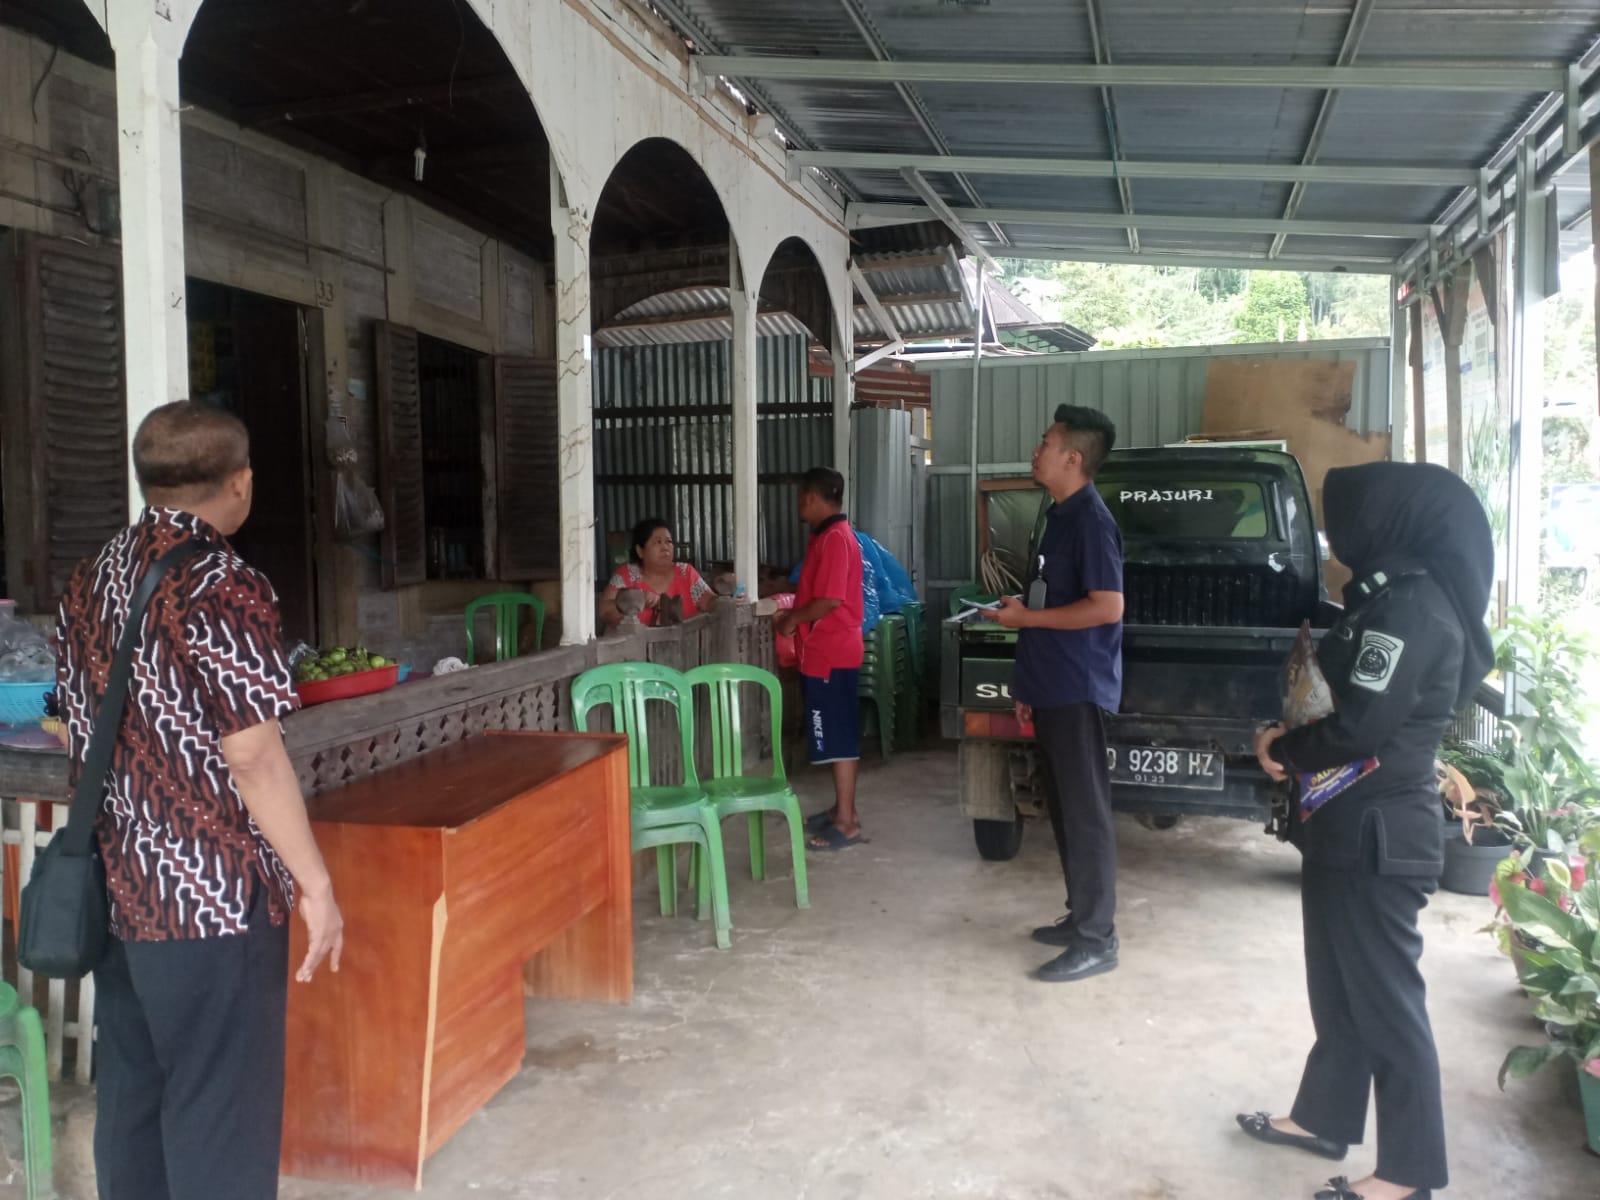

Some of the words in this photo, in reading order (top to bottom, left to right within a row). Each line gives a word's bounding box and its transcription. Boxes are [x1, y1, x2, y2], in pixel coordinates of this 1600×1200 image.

[316, 279, 334, 302] 33
[811, 709, 824, 738] NIKE
[1129, 749, 1178, 774] 9238
[1188, 752, 1214, 776] HZ
